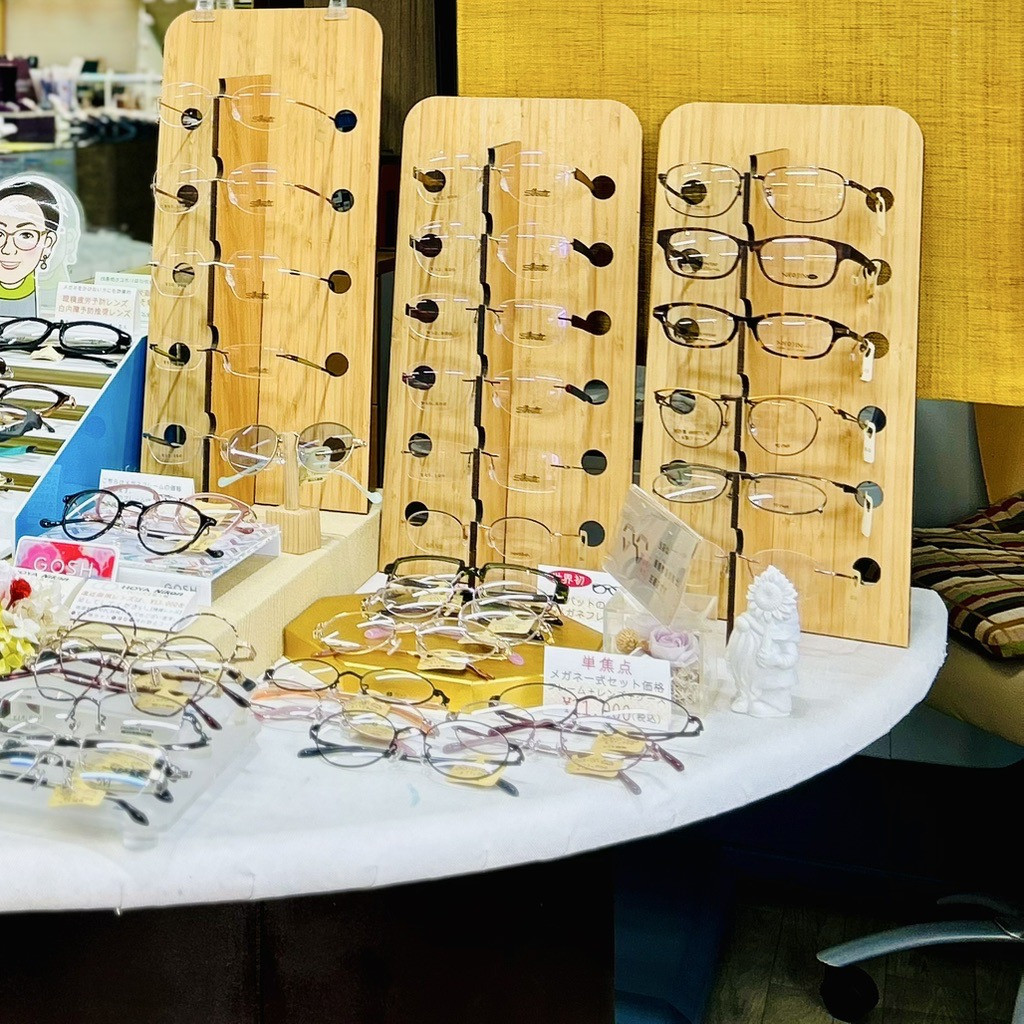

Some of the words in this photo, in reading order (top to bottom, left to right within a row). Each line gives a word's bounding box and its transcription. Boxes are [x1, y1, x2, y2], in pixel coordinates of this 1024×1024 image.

[33, 556, 94, 578] GOSH
[582, 655, 633, 675] 単焦点
